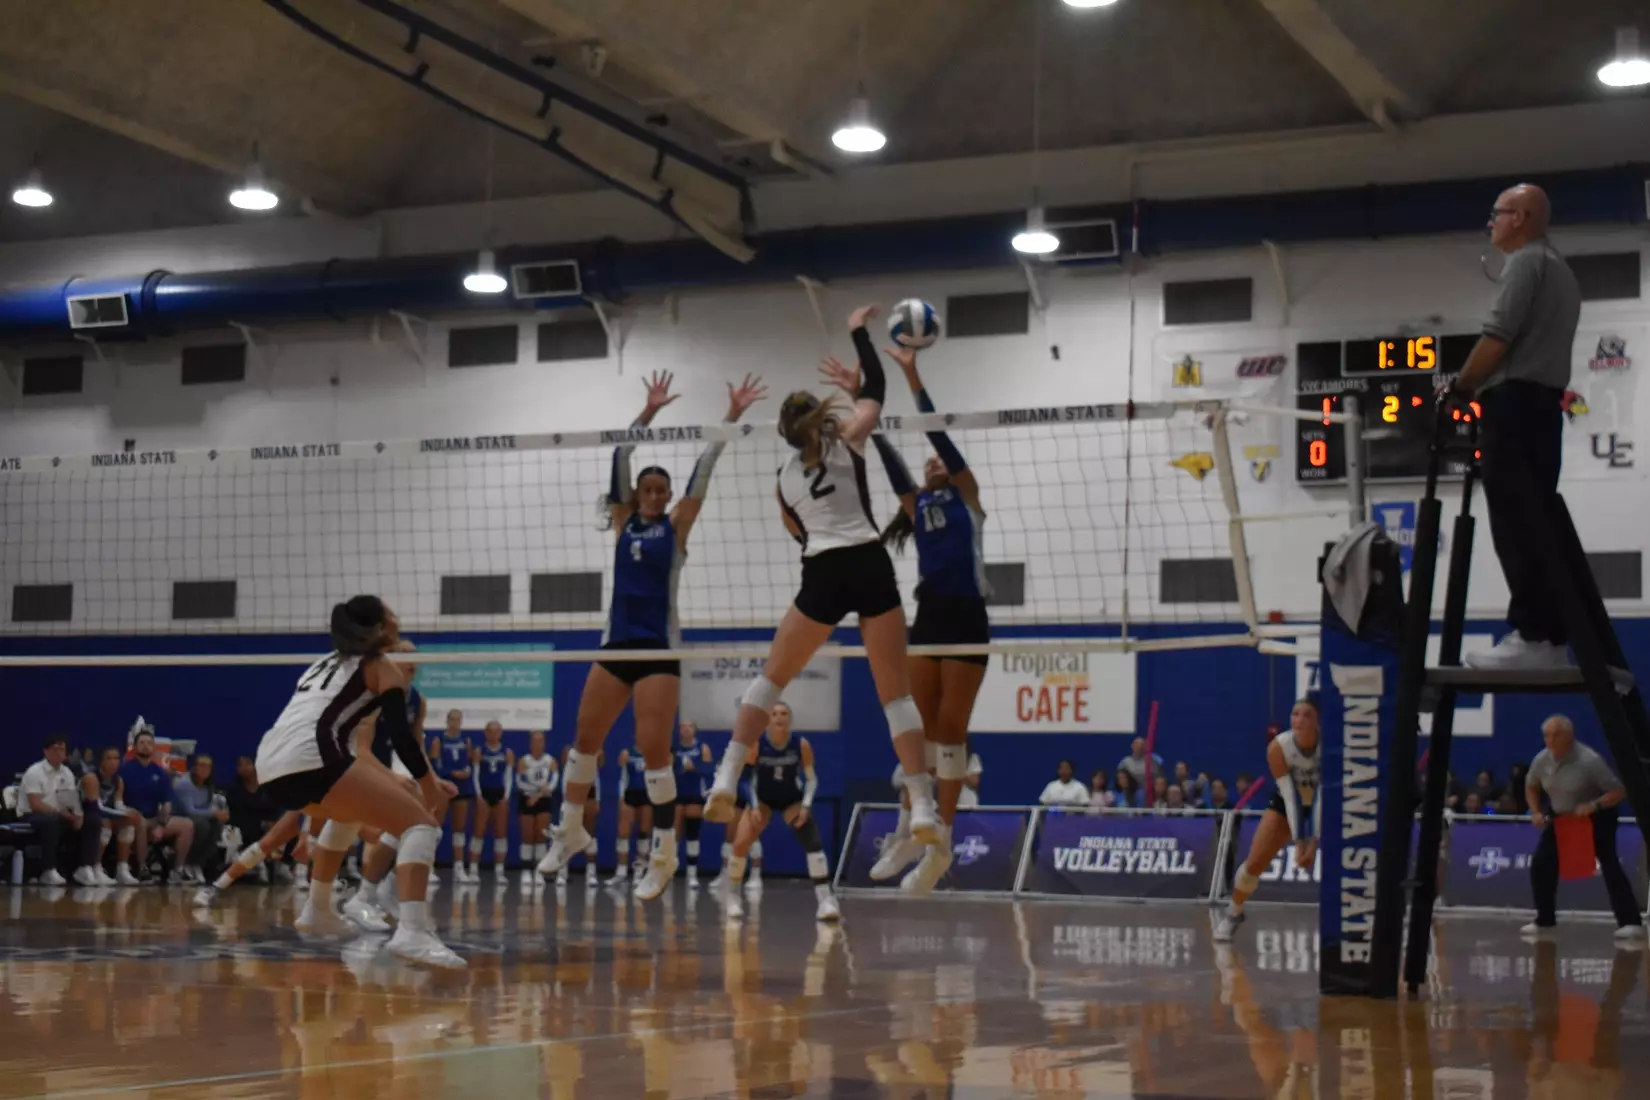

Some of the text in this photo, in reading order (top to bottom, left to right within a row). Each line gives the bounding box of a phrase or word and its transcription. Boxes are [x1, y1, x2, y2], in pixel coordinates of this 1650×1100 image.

[1378, 336, 1436, 369] 1:15
[1000, 404, 1115, 424] INDIANA STATE
[1382, 396, 1400, 423] 2
[420, 435, 517, 452] INDIANA STATE
[601, 426, 703, 444] INDIANA STATE
[0, 457, 22, 471] ATE
[91, 451, 177, 468] INDIANA STATE
[250, 443, 342, 460] INDIANA STATE
[1309, 440, 1328, 467] 0
[1590, 433, 1635, 469] UE
[804, 465, 836, 499] 2
[1002, 651, 1088, 679] tropical
[1016, 684, 1089, 723] CAFE
[1329, 662, 1385, 963] INDIANA STATE
[1079, 836, 1179, 850] INDIANA STATE
[1053, 847, 1198, 875] VOLLEYBALL
